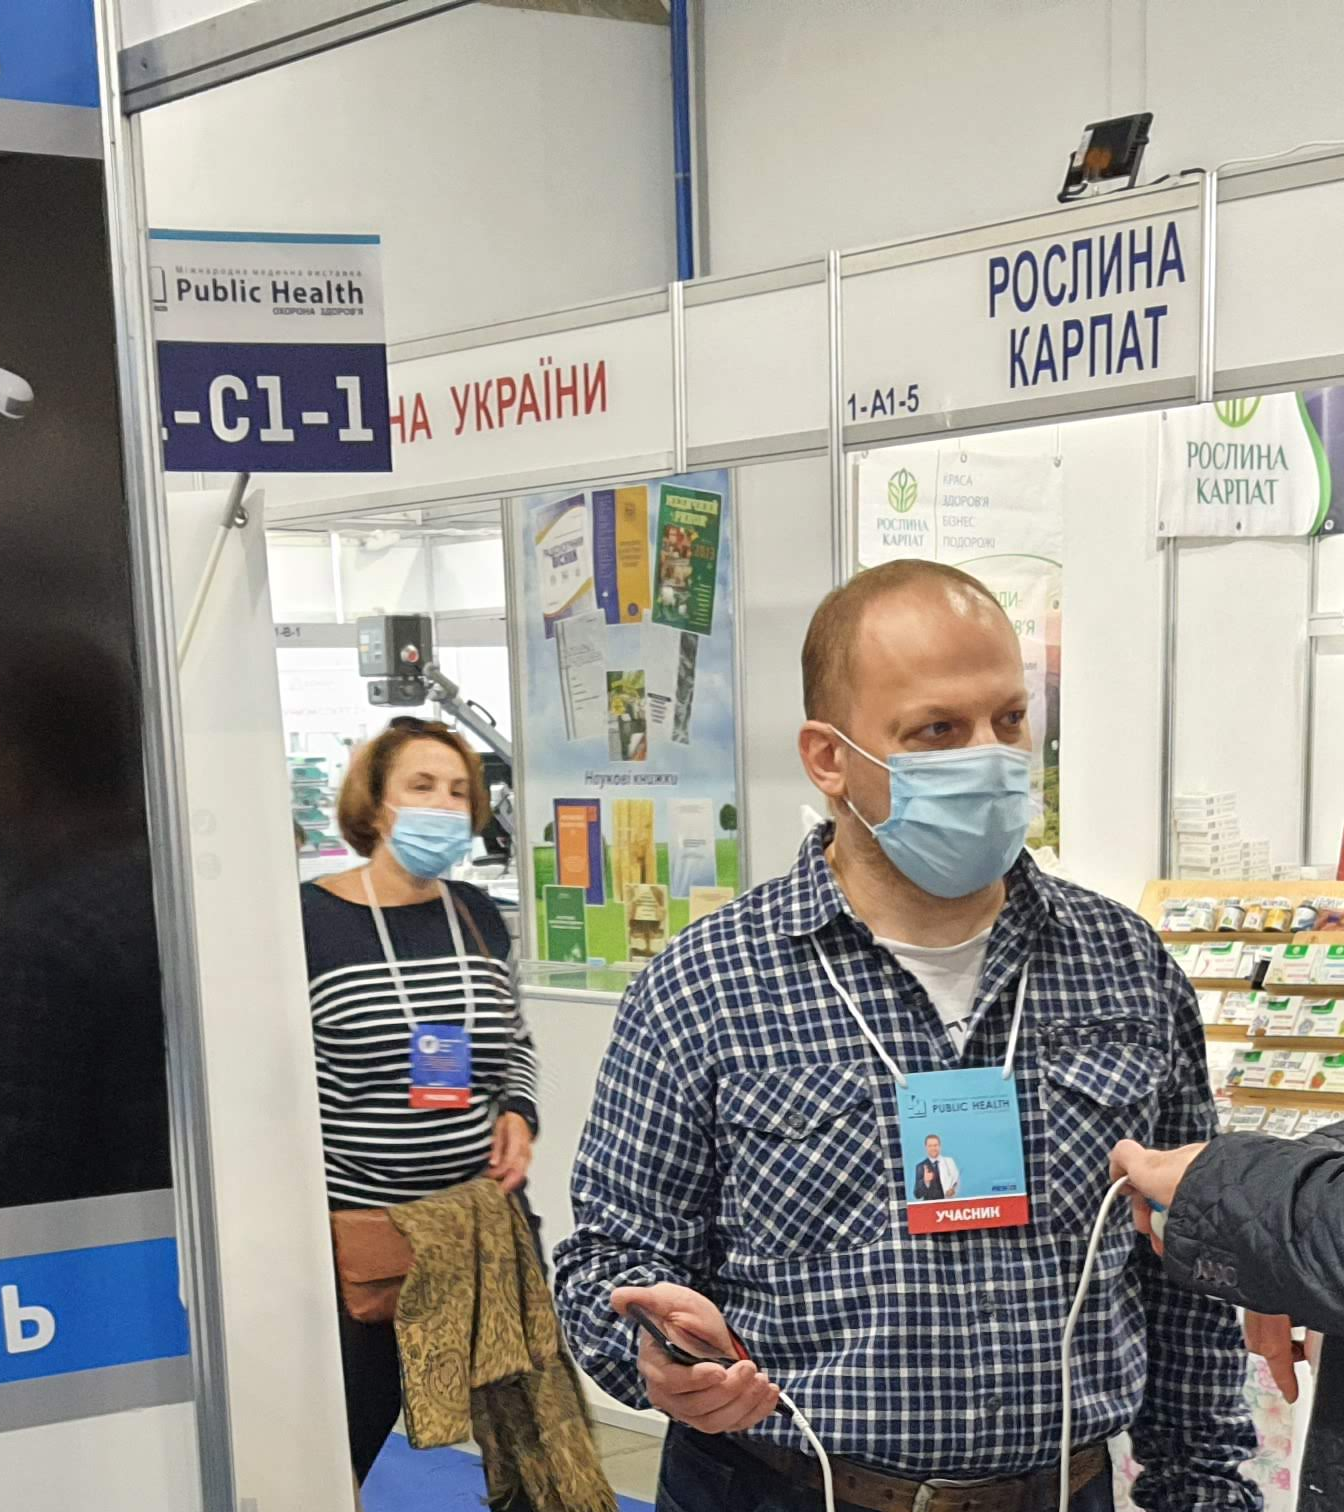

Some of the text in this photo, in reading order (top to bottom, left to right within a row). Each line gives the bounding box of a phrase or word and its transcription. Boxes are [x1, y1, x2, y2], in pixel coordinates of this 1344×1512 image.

[989, 221, 1186, 318] РОСЛИНА
[176, 278, 364, 305] Public Health
[1009, 305, 1169, 389] КАРПАТ
[162, 374, 374, 443] -C1-1
[449, 356, 607, 436] УКРАЇНИ
[847, 384, 921, 421] 1-A1-5
[1186, 440, 1289, 470] РОСЛИНА
[942, 473, 973, 486] КРАСА
[1196, 478, 1279, 505] КАРПАТ
[876, 517, 929, 532] РОСЛИНА
[882, 532, 925, 547] КАРПАТ
[932, 1099, 1010, 1114] PUBLIC HEALTH
[935, 1205, 1001, 1224] УЧАСНИК
